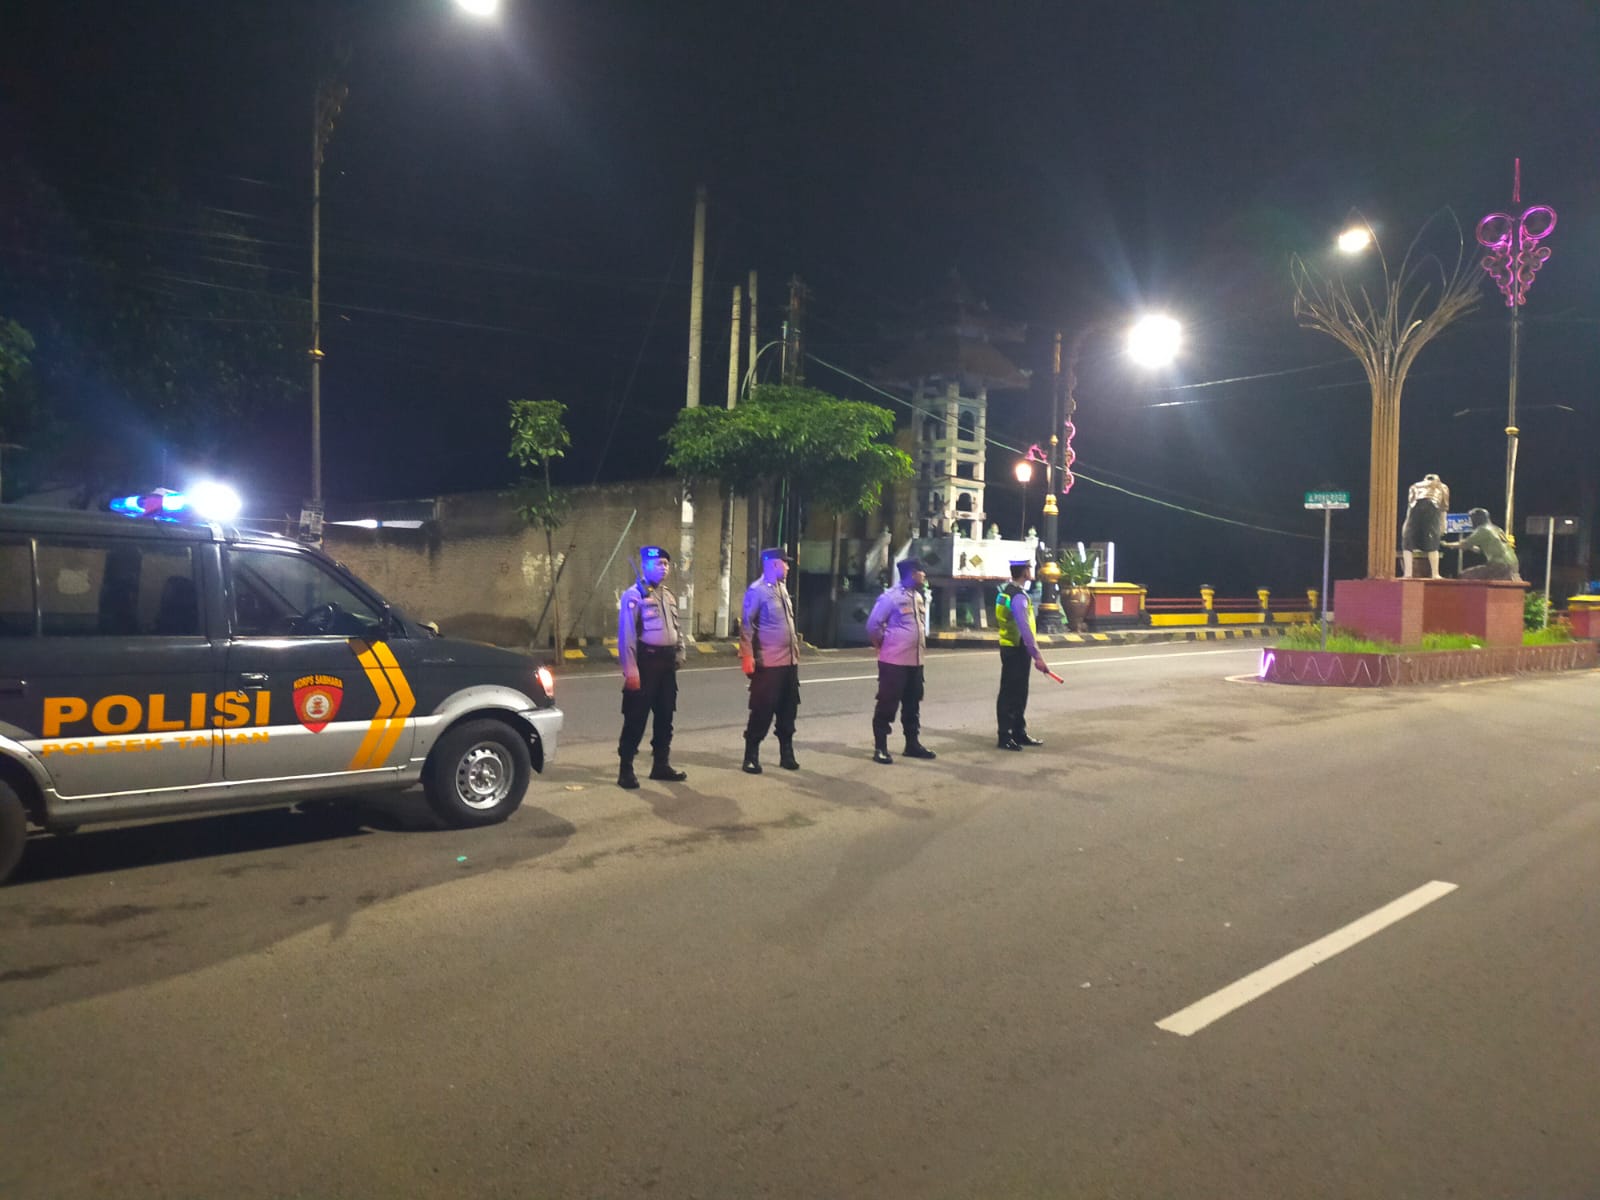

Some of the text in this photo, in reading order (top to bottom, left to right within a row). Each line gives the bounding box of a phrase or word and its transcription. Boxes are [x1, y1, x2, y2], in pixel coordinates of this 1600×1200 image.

[293, 675, 314, 689] KORPS
[43, 691, 270, 737] POLISI
[42, 738, 163, 757] POLSEK
